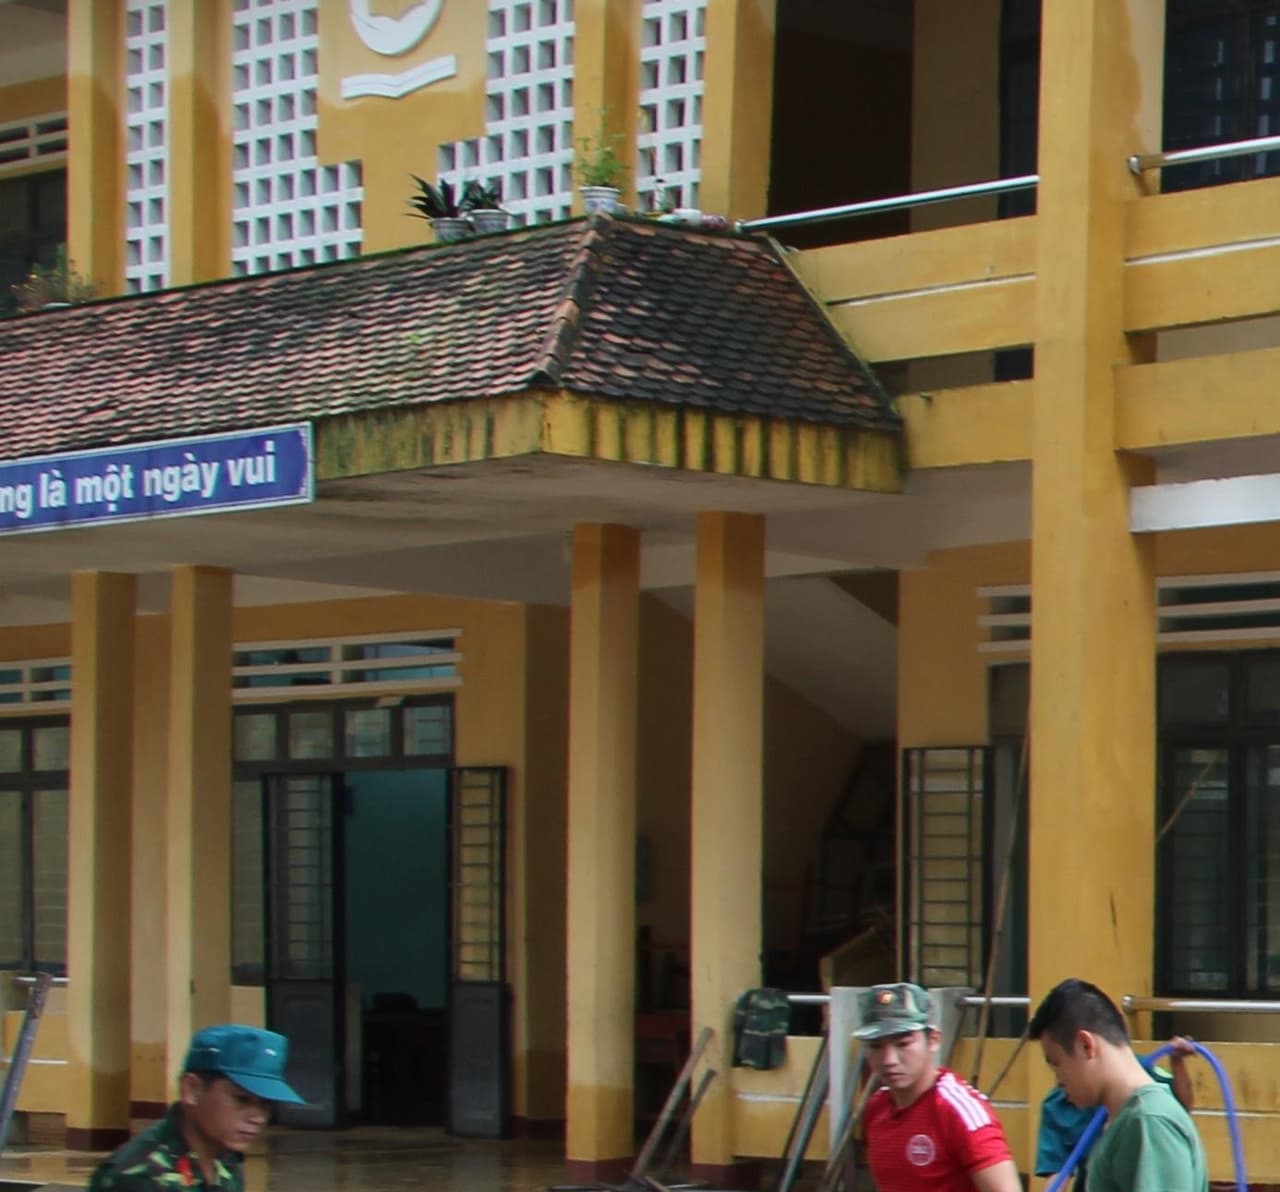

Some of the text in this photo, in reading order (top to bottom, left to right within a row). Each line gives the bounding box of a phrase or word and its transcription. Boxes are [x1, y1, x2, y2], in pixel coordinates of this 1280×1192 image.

[40, 468, 66, 508] là
[76, 464, 133, 512] một
[144, 453, 219, 501] ngày
[227, 441, 275, 485] vui
